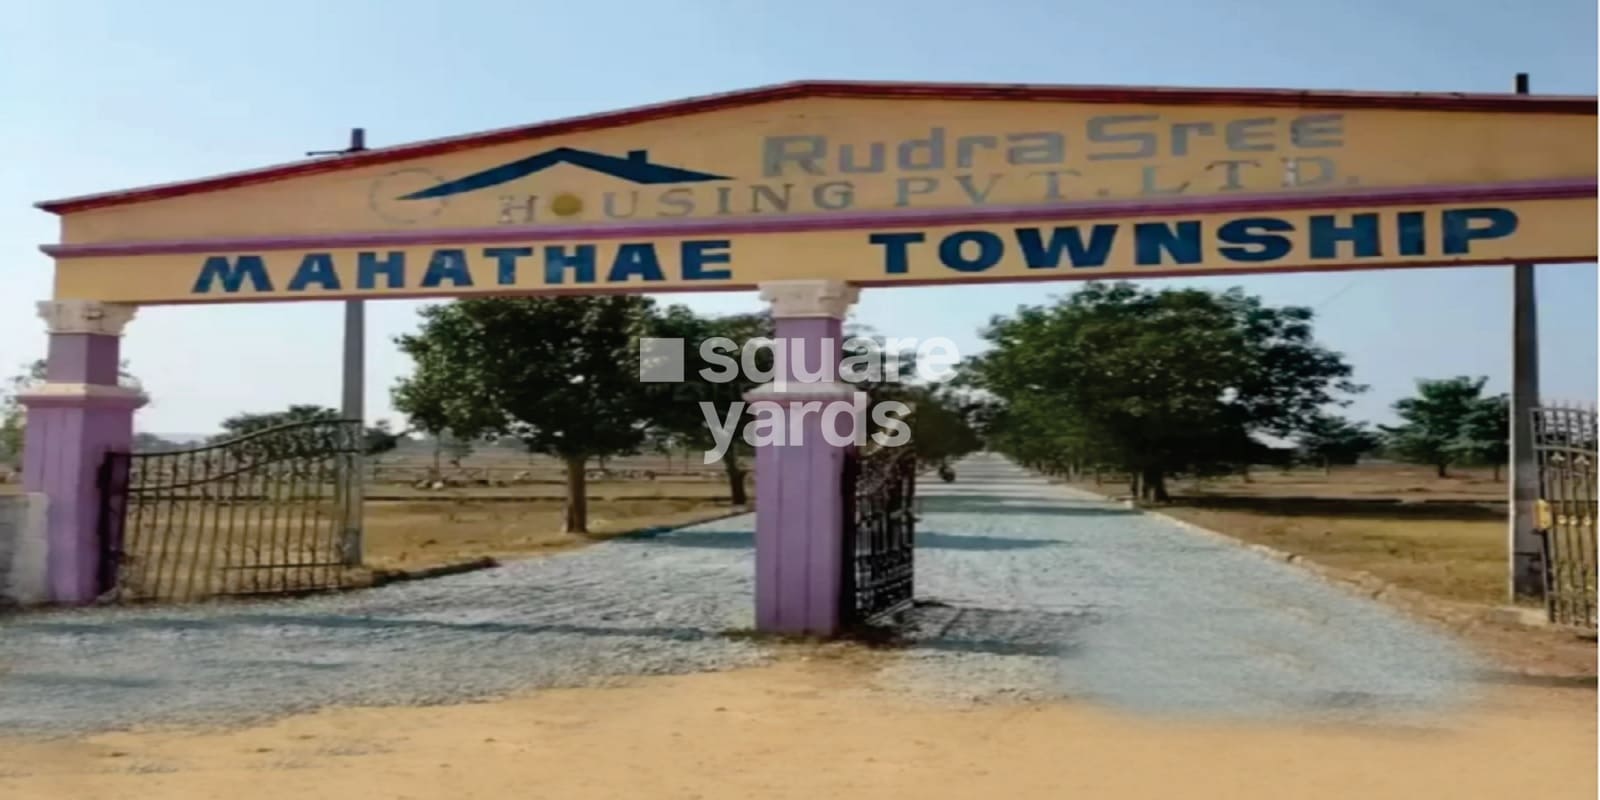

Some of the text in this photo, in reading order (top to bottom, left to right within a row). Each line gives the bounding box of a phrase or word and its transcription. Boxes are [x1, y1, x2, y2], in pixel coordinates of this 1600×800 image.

[763, 127, 1065, 178] Rudra
[192, 207, 1519, 293] MAHATHAE TOWNSHIP
